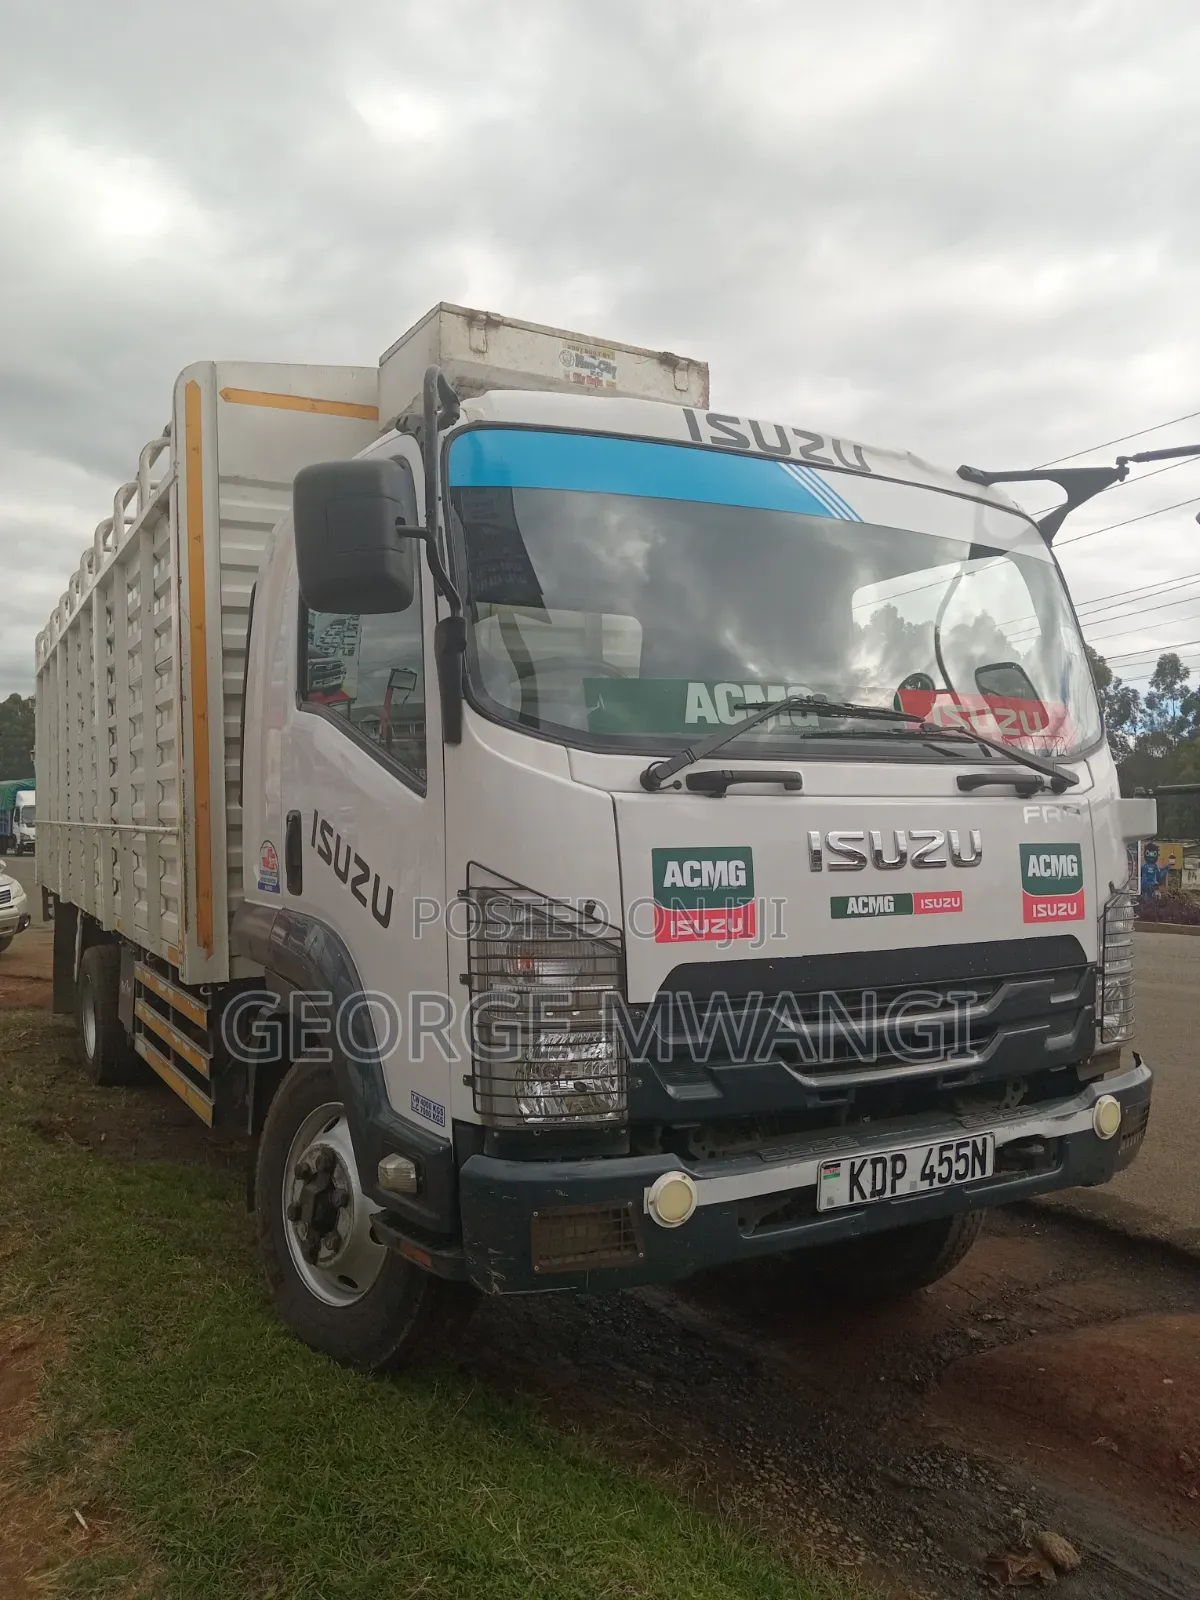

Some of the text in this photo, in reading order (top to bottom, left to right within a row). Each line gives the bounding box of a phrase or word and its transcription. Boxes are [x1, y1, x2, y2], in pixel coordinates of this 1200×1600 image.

[682, 408, 871, 472] ISUZU
[932, 703, 1042, 736] ISUZU
[807, 829, 982, 872] ISUZU
[311, 809, 394, 929] ISUZU
[663, 860, 747, 892] ACMG
[1027, 854, 1079, 880] ACMG
[846, 895, 960, 915] ACMG ISUZU
[1032, 903, 1077, 917] ISUZU
[670, 917, 743, 936] ISUZU
[432, 1104, 444, 1116] KGS
[432, 1113, 444, 1124] KGS
[849, 1137, 987, 1202] KDP 455N
